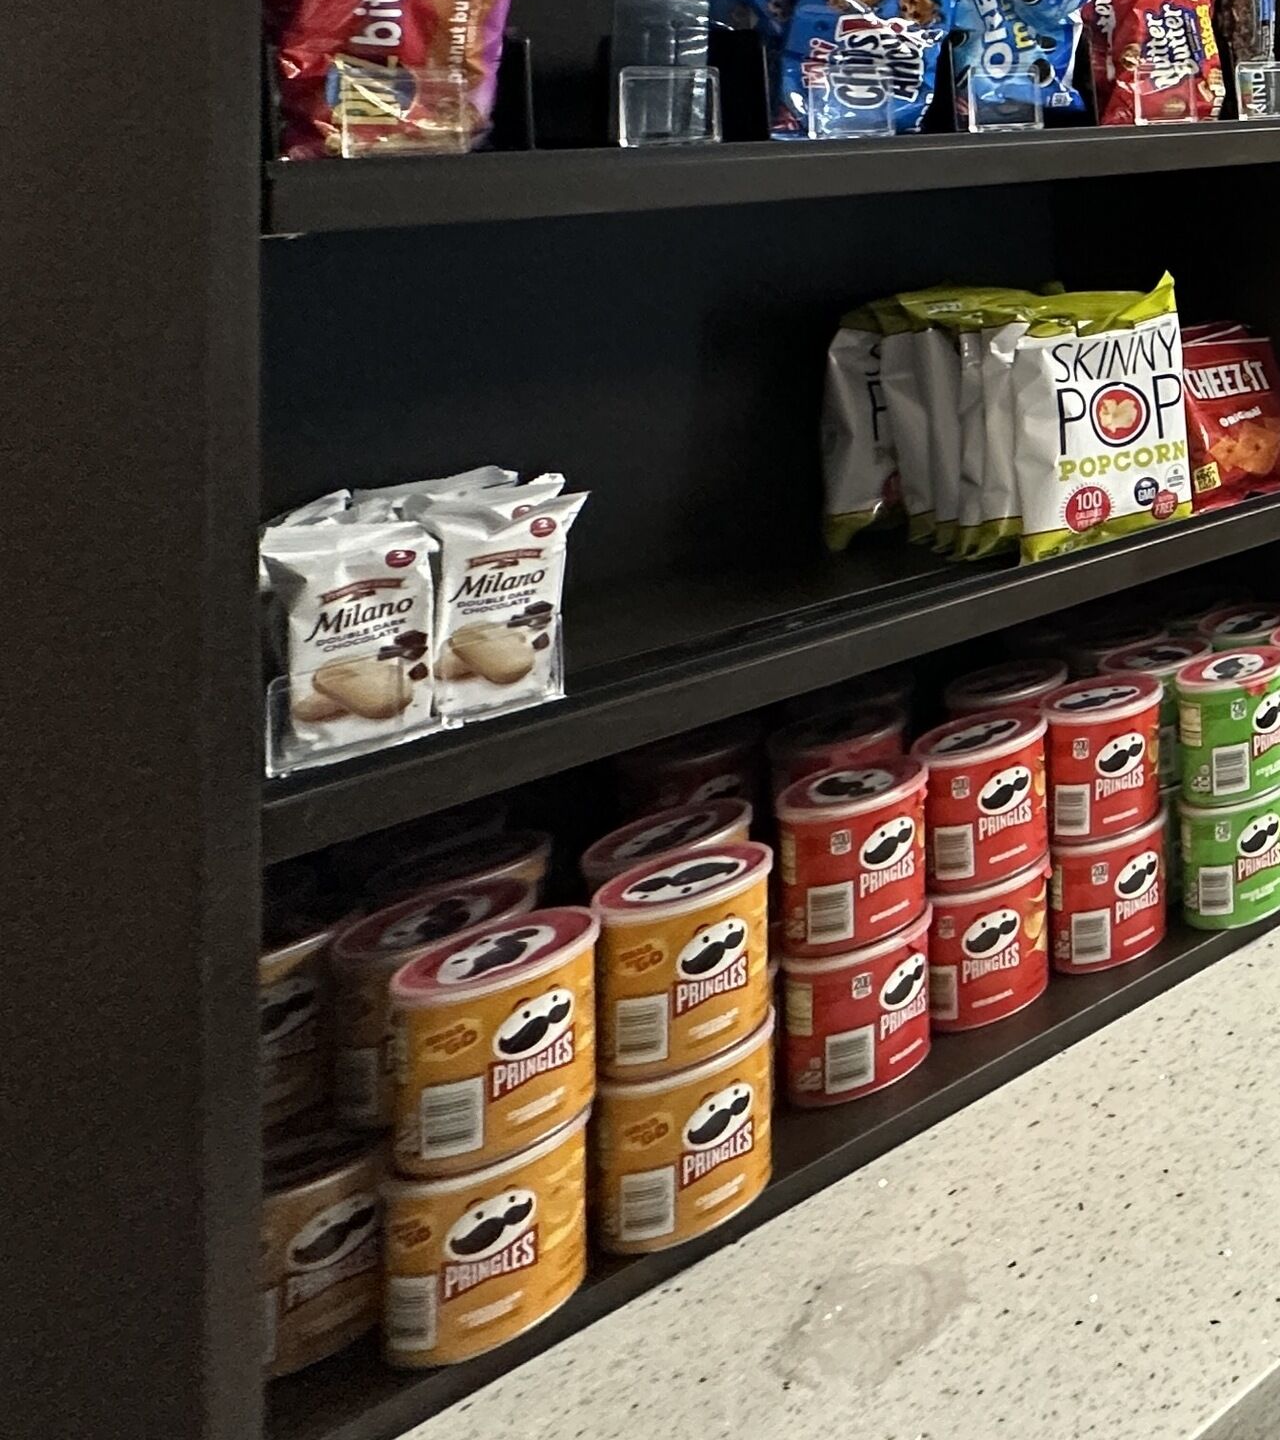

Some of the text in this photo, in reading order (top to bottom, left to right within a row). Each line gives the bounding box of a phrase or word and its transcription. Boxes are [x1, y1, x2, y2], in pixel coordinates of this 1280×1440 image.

[448, 25, 470, 86] peanut
[1146, 13, 1181, 88] Nutter
[1163, 4, 1200, 77] Butter
[829, 33, 886, 109] CHIPS
[1253, 71, 1266, 117] KIND
[1051, 329, 1179, 383] SKINNY
[1057, 372, 1184, 456] POP
[1058, 441, 1185, 482] POPCORN
[1075, 491, 1103, 511] 100
[448, 569, 546, 603] Milano
[457, 594, 506, 608] DOUBLE
[462, 597, 531, 615] CHOCOLATE
[303, 597, 414, 643] Milano
[316, 627, 370, 647] DOUBLE
[323, 626, 400, 653] CHOCOLATE
[1095, 764, 1144, 801] PRINGLES
[978, 798, 1032, 841] PRINGLES
[859, 851, 915, 899] PRINGLES
[1237, 842, 1280, 881] PRINGLES
[1115, 883, 1159, 924] PRINGLES
[675, 955, 747, 1014] PRINGLES
[962, 942, 1020, 984] PRINGLES
[880, 987, 926, 1041] PRINGLES
[492, 1033, 574, 1097] PRINGLES
[682, 1120, 753, 1186] PRINGLES
[444, 1230, 536, 1298] PRINGLES
